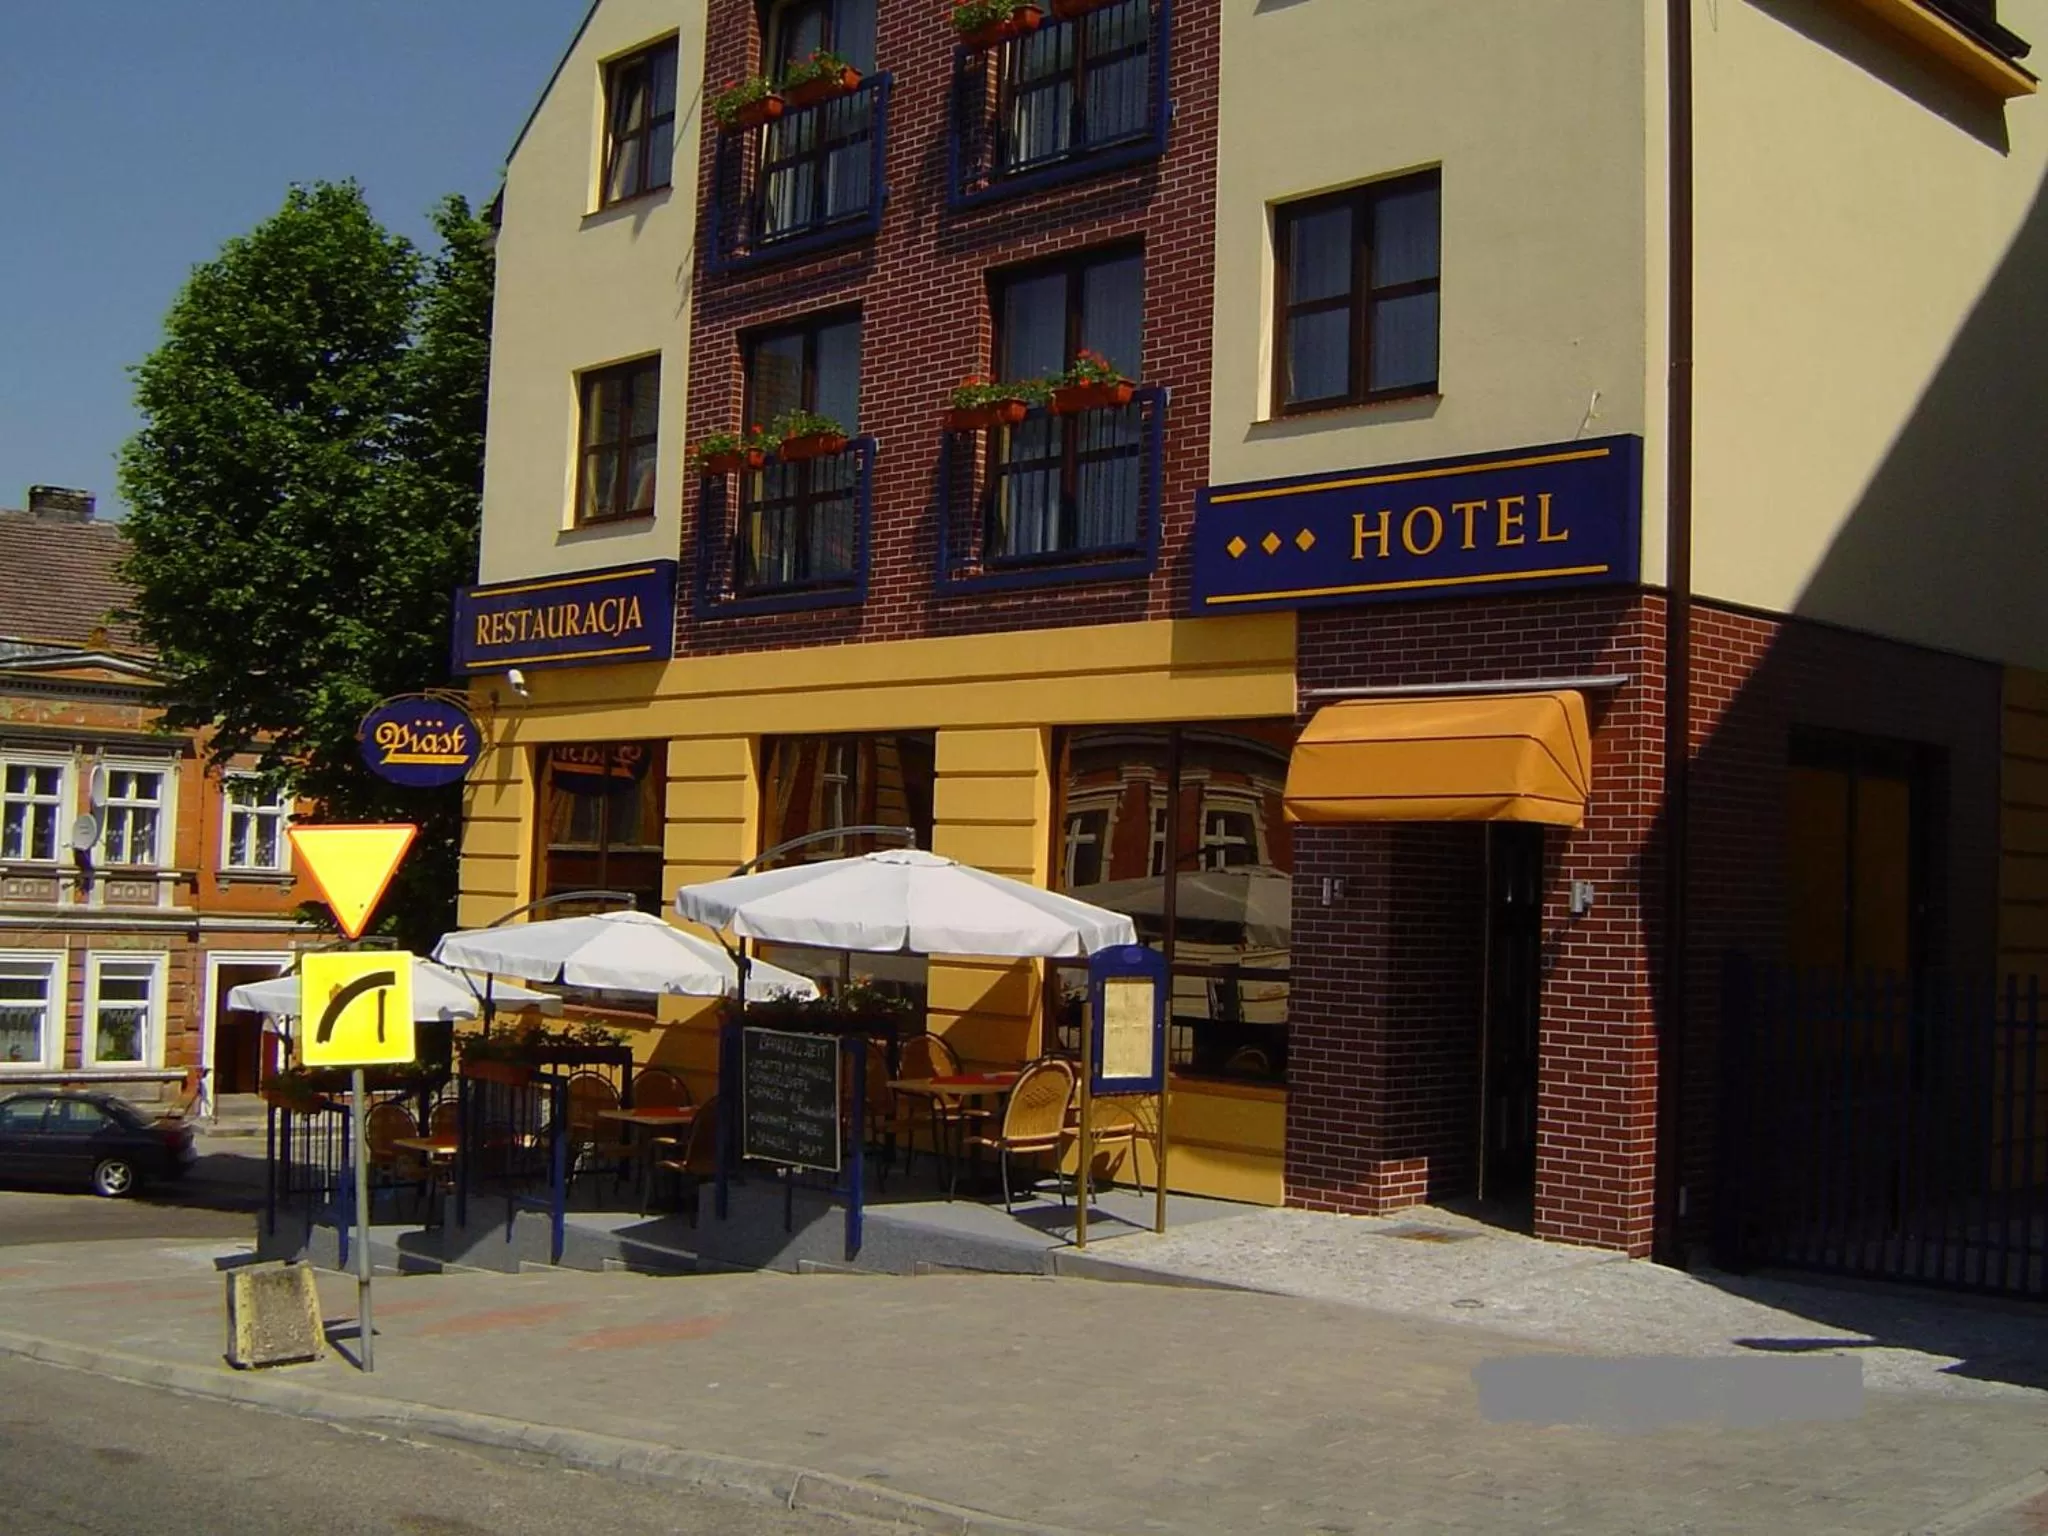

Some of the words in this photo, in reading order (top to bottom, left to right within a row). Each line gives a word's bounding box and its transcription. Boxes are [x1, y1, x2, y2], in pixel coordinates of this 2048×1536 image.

[1351, 493, 1569, 560] HOTEL
[476, 596, 643, 646] RESTAURACJA
[375, 721, 468, 764] Piast
